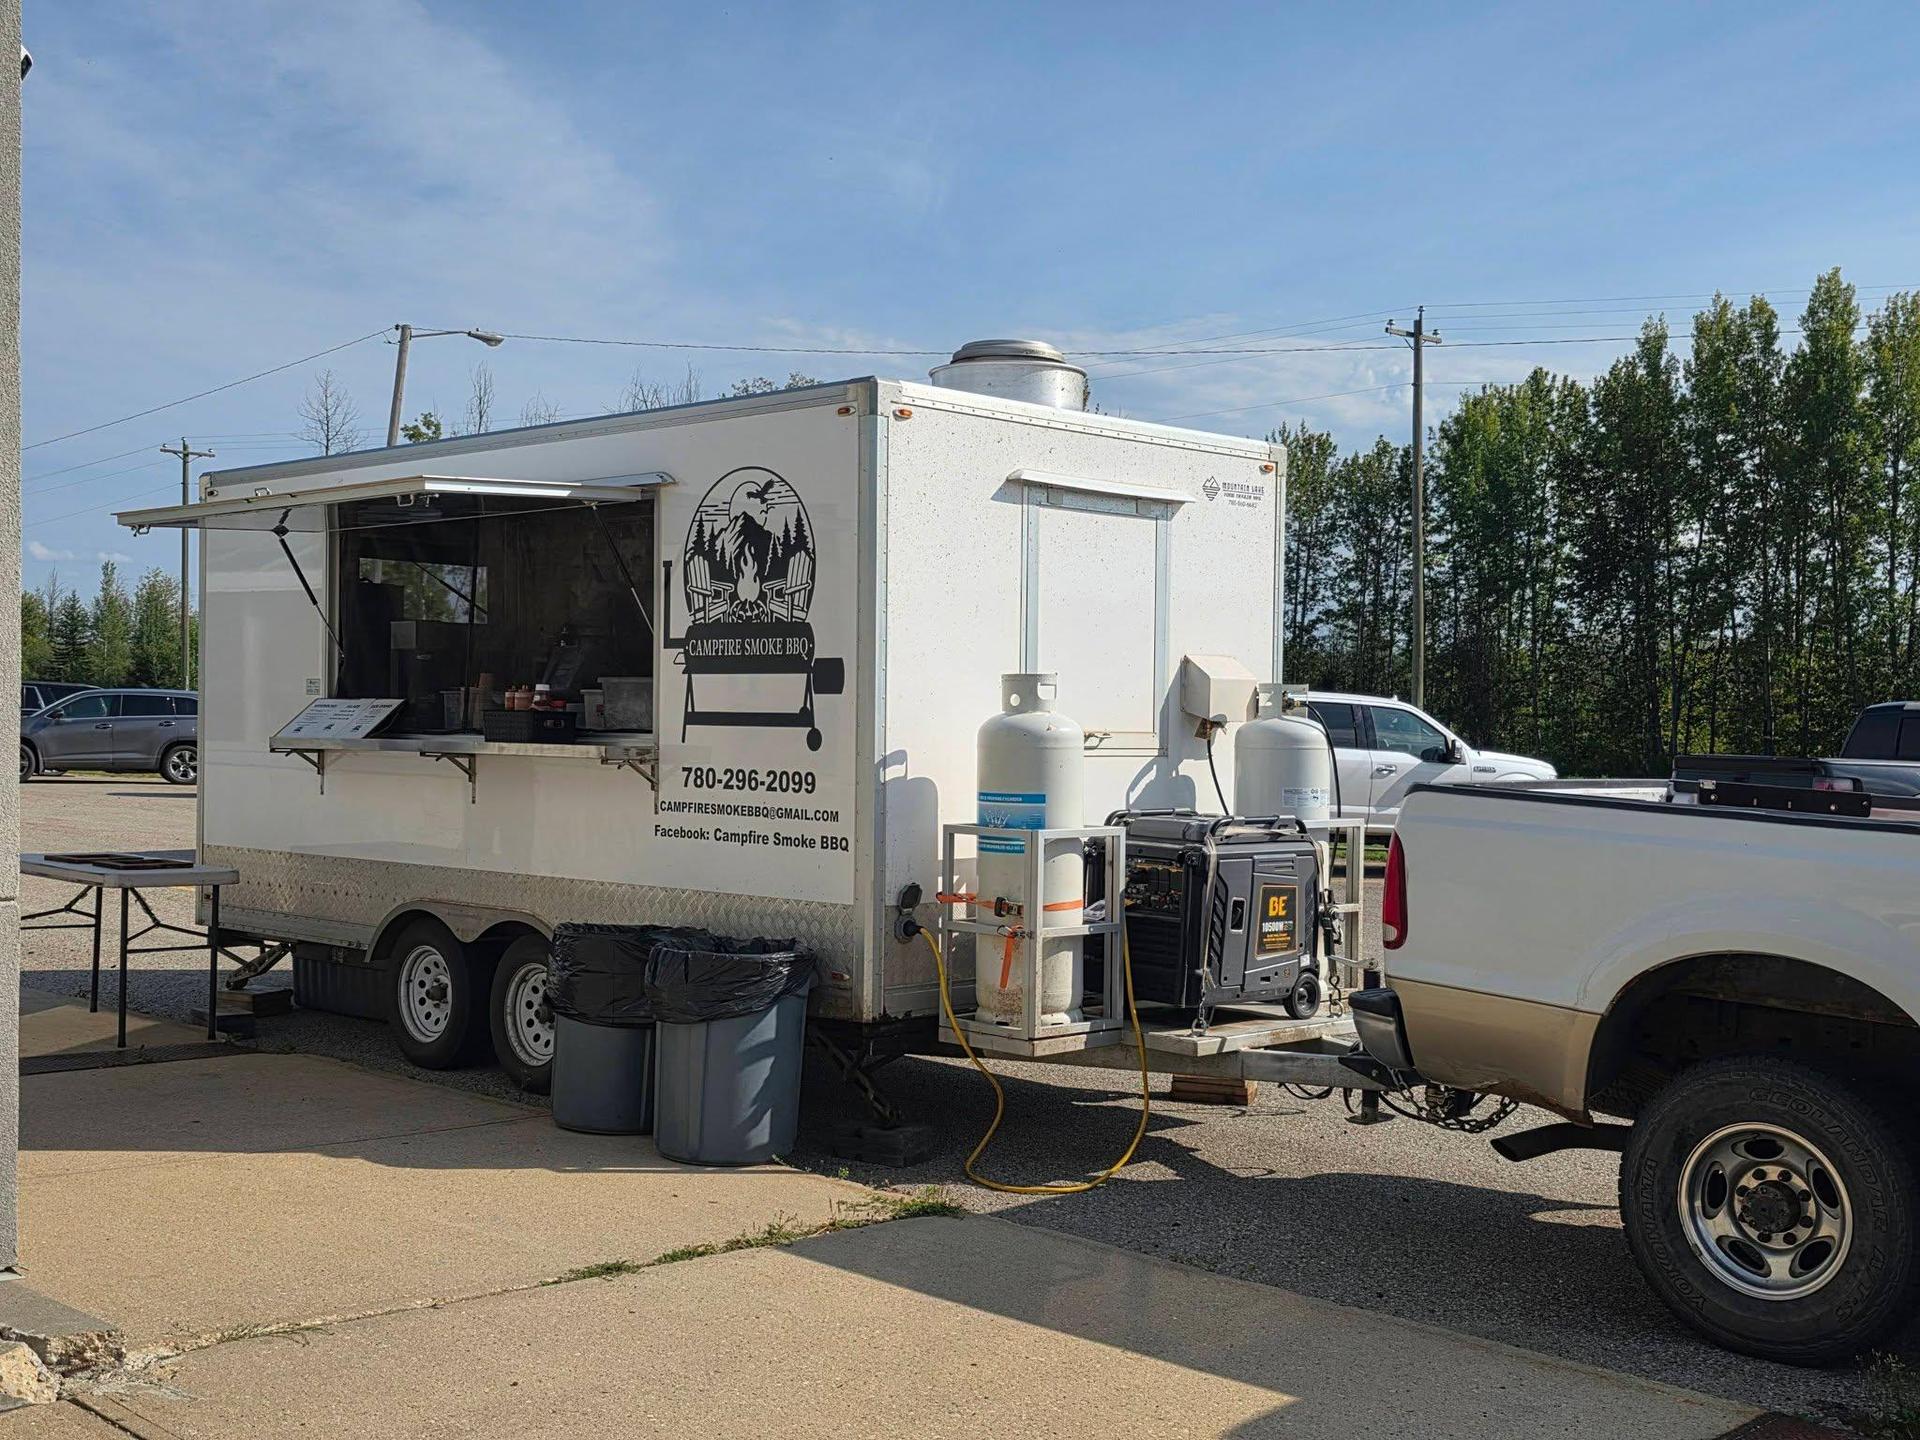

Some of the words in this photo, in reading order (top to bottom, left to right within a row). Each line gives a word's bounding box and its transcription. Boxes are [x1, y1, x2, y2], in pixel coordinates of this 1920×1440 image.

[689, 638, 742, 656] CAMPFIRE
[744, 637, 783, 656] SMOKE
[786, 637, 809, 661] BBQ
[682, 766, 816, 794] 780-296-2099
[660, 800, 839, 823] CAMPFIRESMOKEBBQ@GMAIL.COM
[654, 824, 710, 841] Facebook:
[714, 827, 769, 846] Campfire
[773, 832, 816, 849] Smoke
[820, 835, 849, 852] BBQ
[1269, 896, 1288, 916] BE
[1749, 1087, 1888, 1234] GEOLANDAR
[1640, 1157, 1706, 1312] YOKOHAMA
